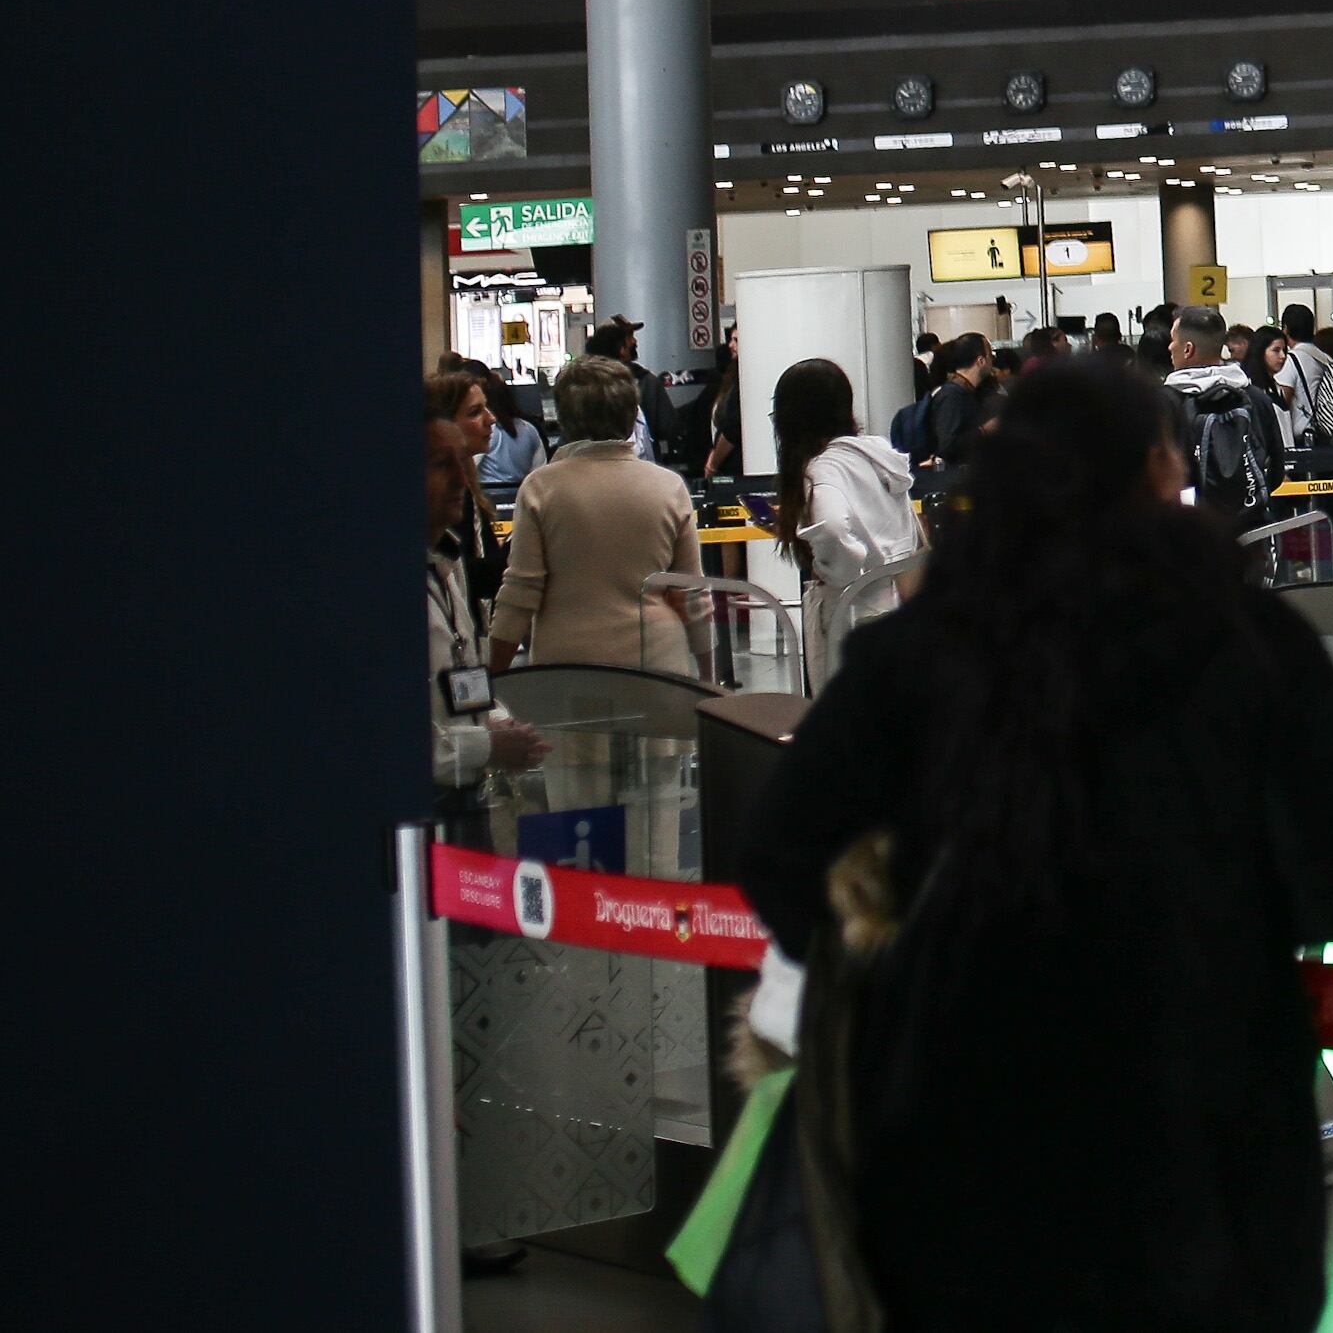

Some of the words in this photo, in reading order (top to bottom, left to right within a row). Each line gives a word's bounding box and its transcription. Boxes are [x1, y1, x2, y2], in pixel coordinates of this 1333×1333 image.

[771, 144, 788, 154] LOS
[521, 202, 589, 221] SALIDA
[1201, 275, 1216, 296] 2
[594, 889, 671, 932] Droguería
